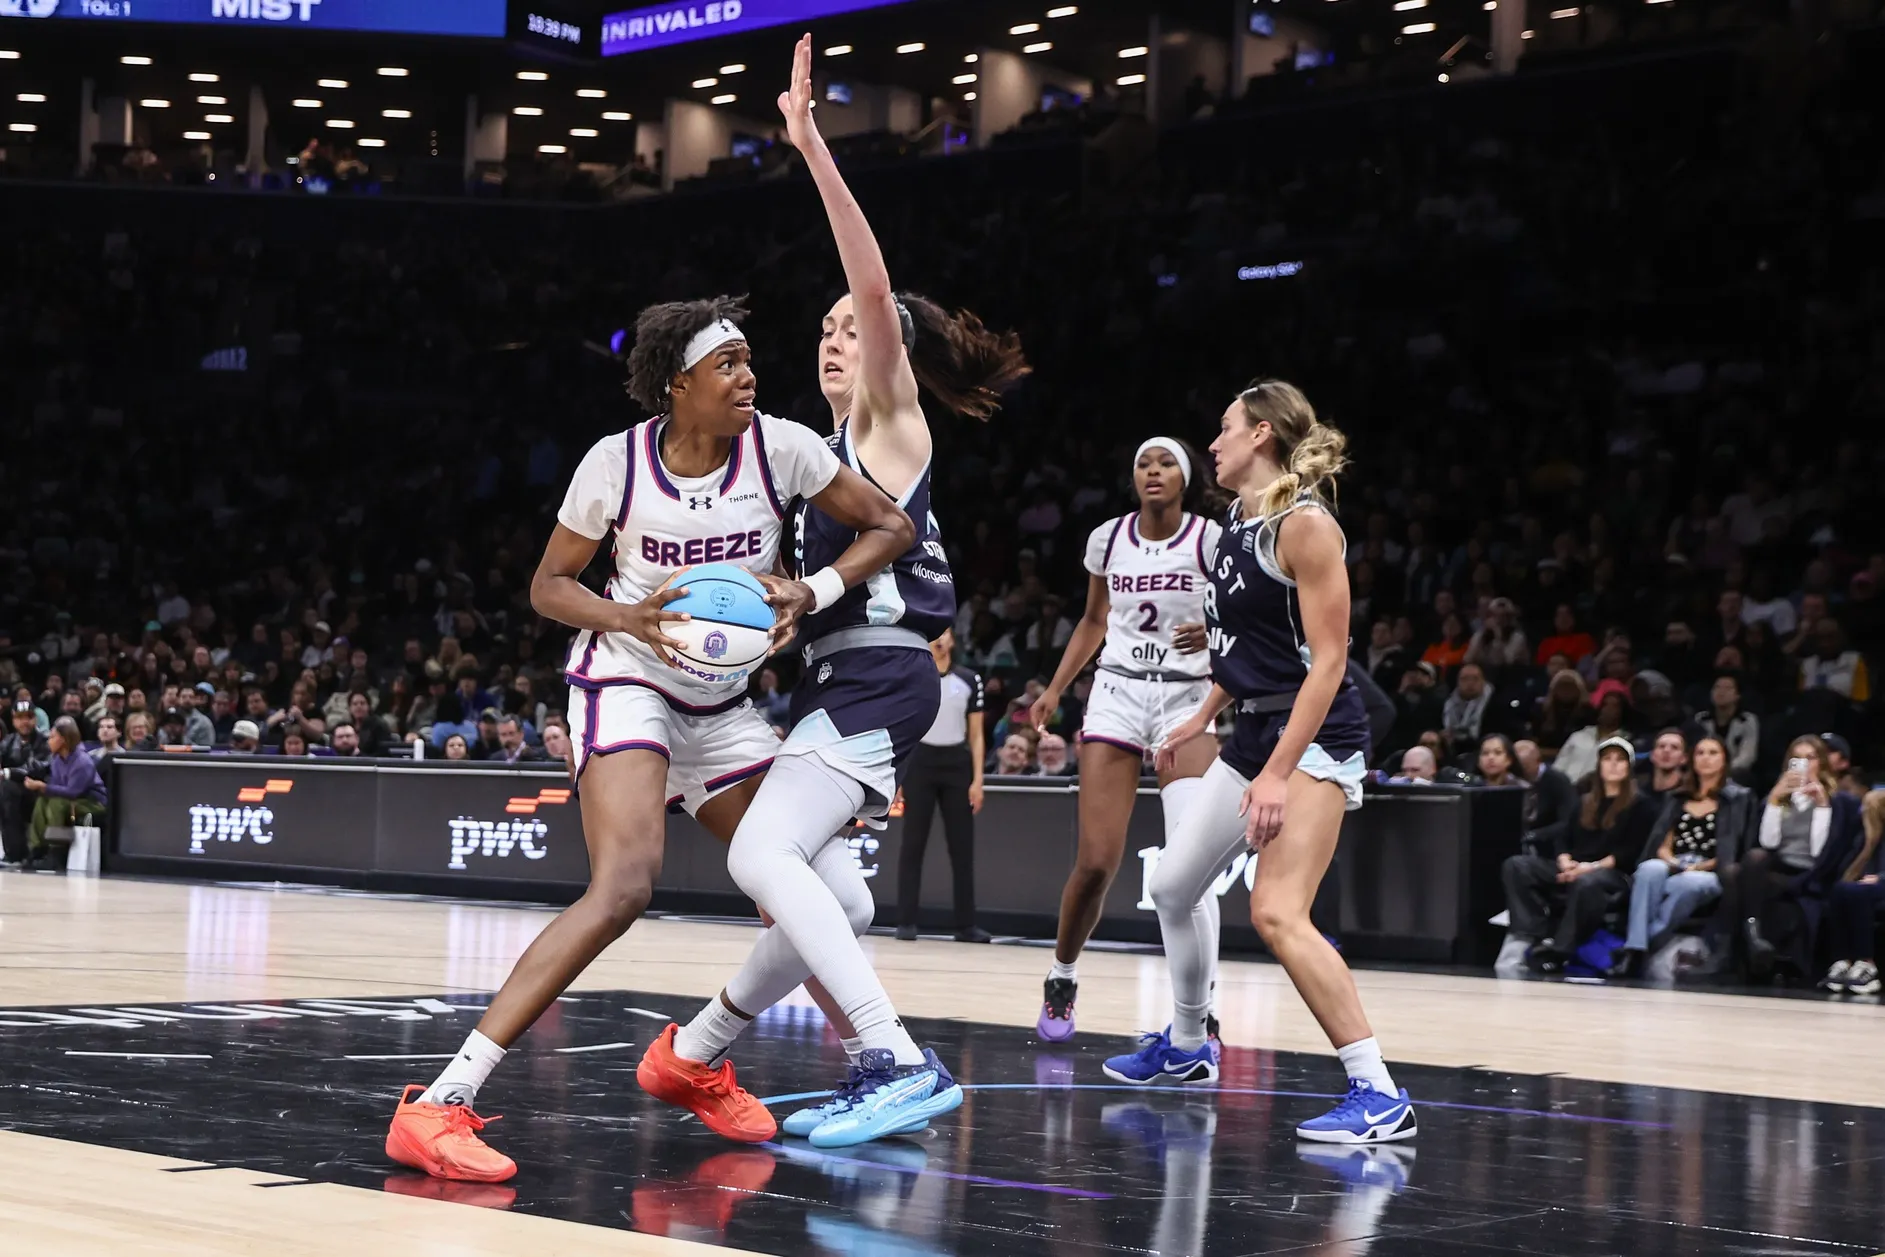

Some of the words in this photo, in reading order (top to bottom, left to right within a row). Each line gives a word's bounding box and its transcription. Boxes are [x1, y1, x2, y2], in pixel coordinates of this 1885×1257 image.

[123, 1, 131, 16] 1
[211, 0, 320, 21] MIST
[729, 492, 759, 503] THORNE
[641, 530, 762, 567] BREEZE
[911, 562, 952, 584] Morgan
[1210, 547, 1246, 595] IST
[1112, 573, 1193, 593] BREEZE
[1138, 601, 1159, 632] 2
[1132, 642, 1168, 665] ally
[189, 803, 273, 853] pwc
[448, 816, 547, 869] pwc
